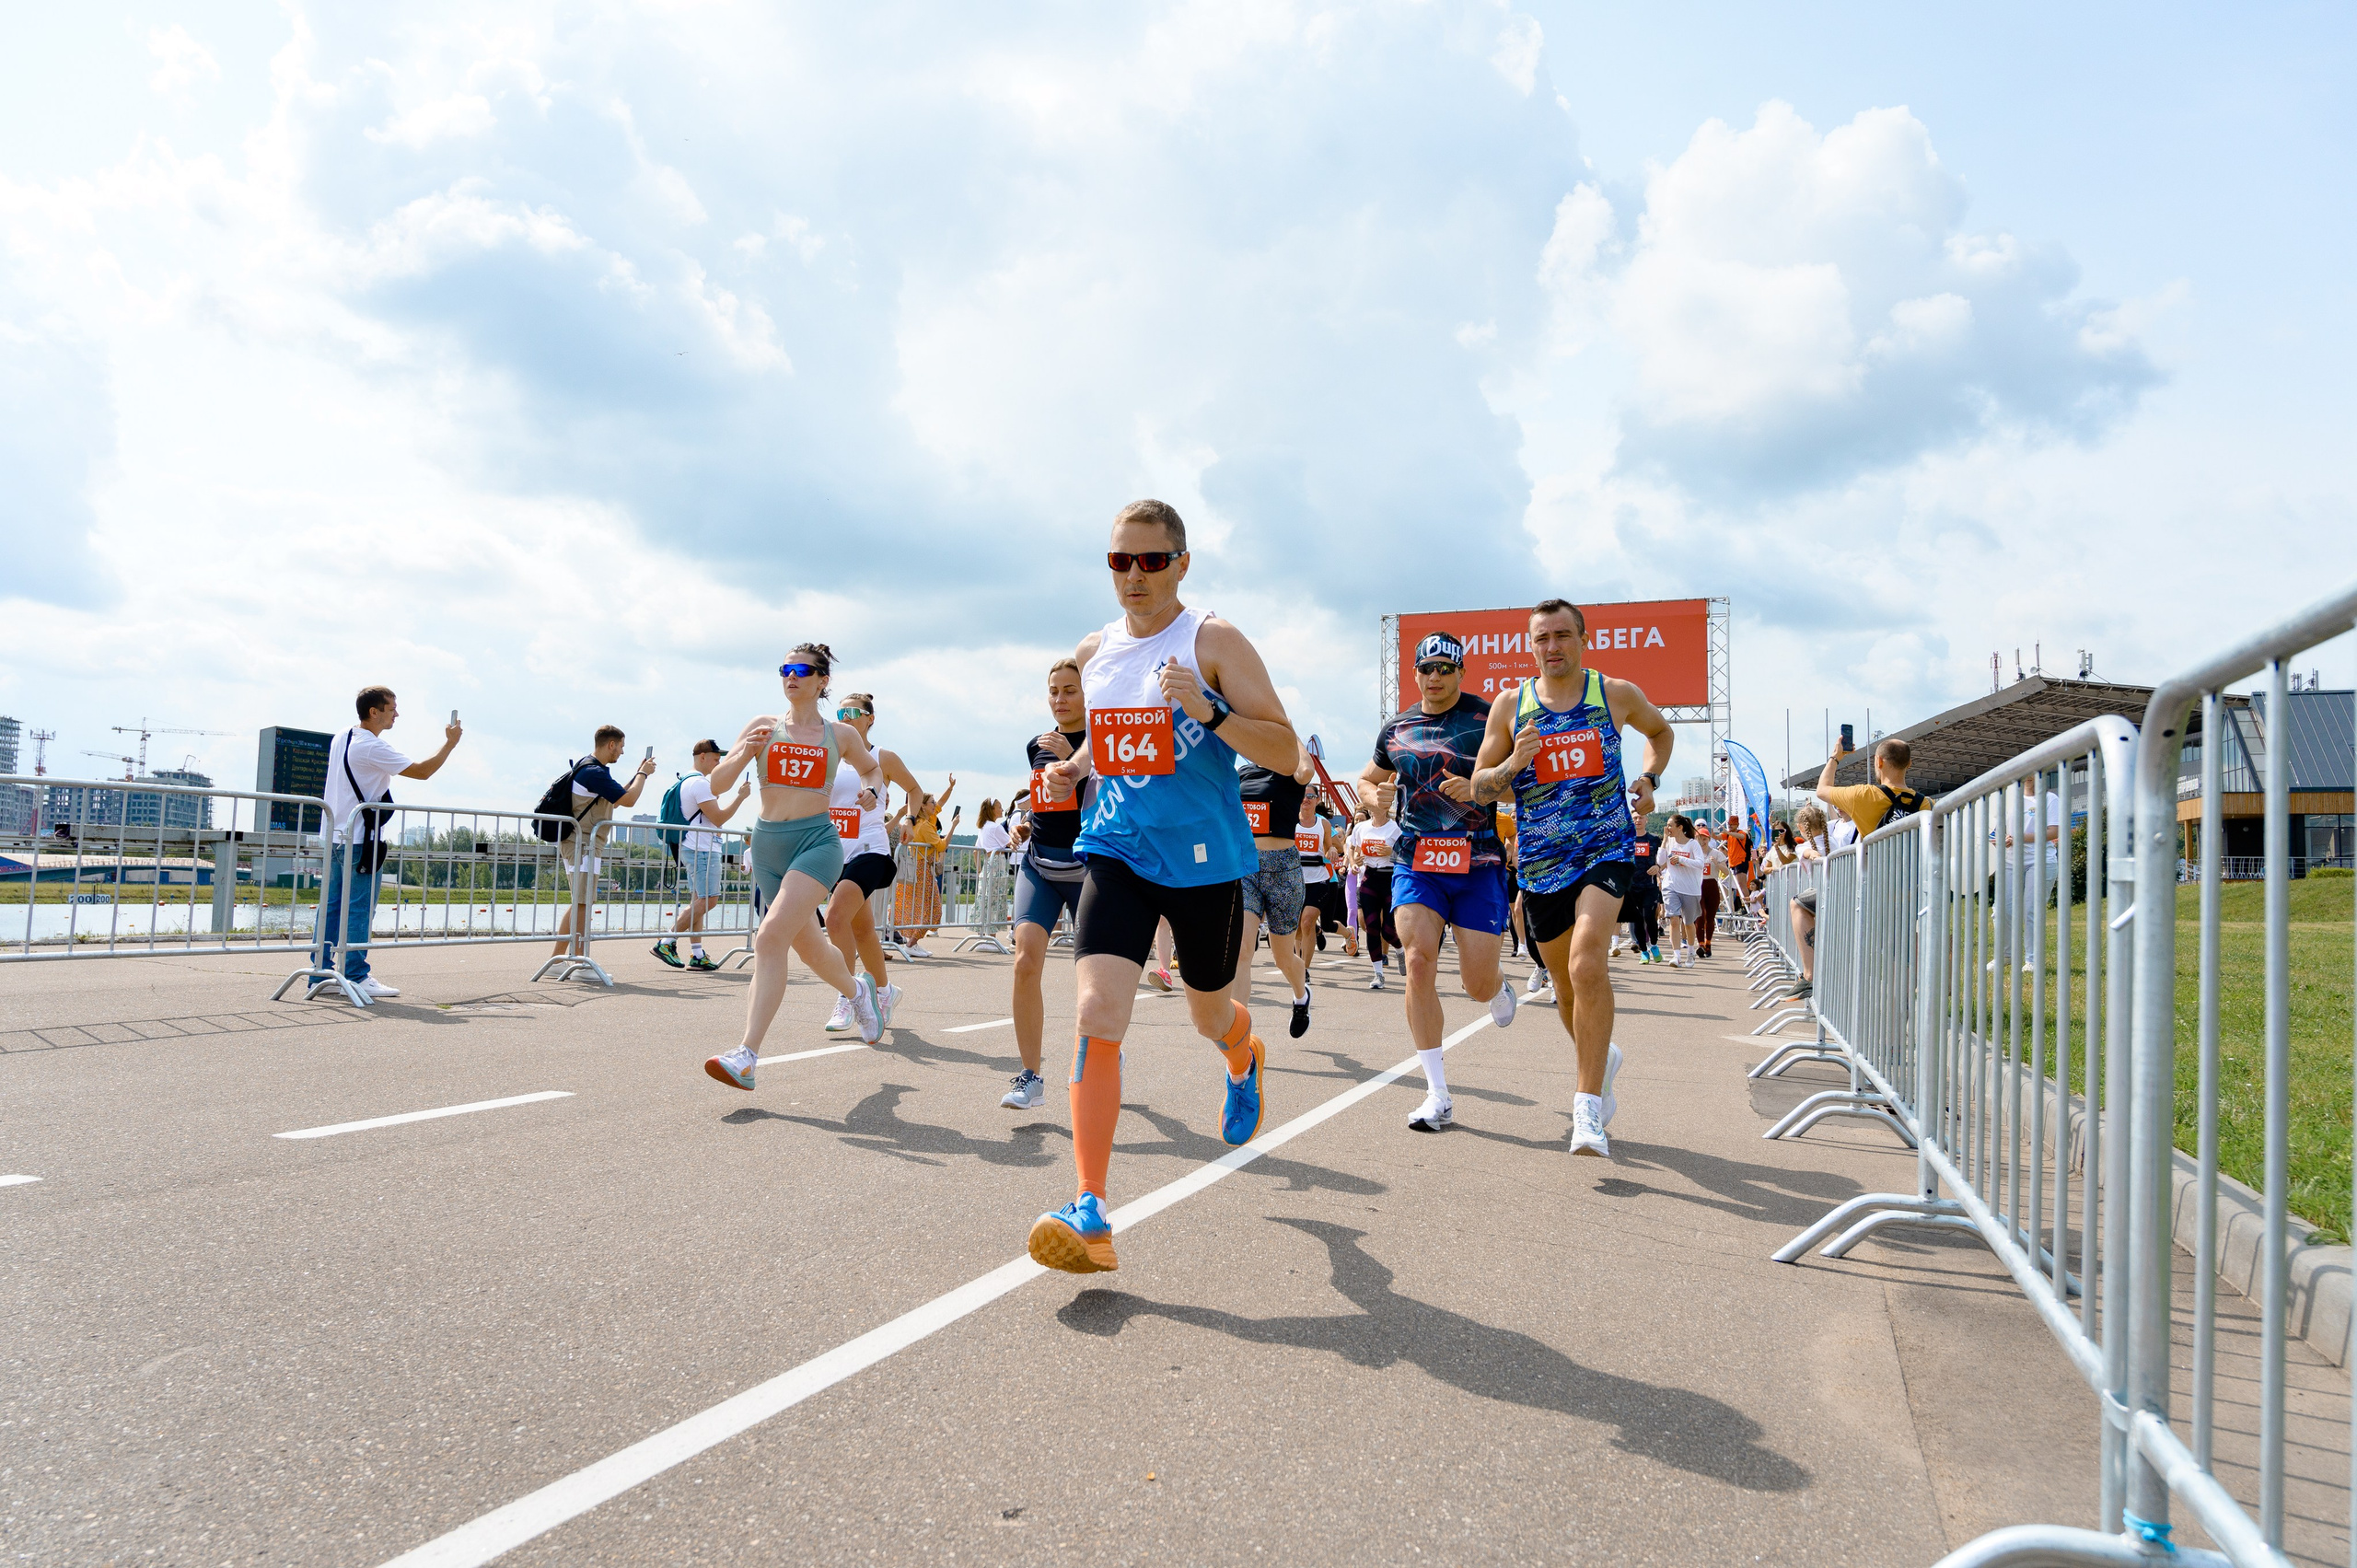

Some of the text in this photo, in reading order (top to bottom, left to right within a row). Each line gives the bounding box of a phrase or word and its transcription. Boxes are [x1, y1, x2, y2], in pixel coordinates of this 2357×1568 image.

[1461, 626, 1666, 656] ИНИ БЕГА
[1488, 662, 1507, 670] 500м
[1482, 678, 1494, 692] Я
[1095, 709, 1166, 726] Я С ТОБОЙ
[1545, 738, 1553, 747] С
[1553, 730, 1595, 746] ТОБОЙ
[789, 747, 824, 758] ТОБОЙ
[1104, 733, 1158, 762] 164
[1547, 748, 1585, 772] 119
[779, 759, 815, 779] 137
[1036, 785, 1053, 804] 10
[1246, 813, 1260, 828] 52
[1298, 840, 1315, 849] 195
[1365, 845, 1377, 854] 19
[1434, 838, 1467, 847] ТОБОЙ
[1422, 851, 1460, 867] 200
[97, 895, 110, 903] 200
